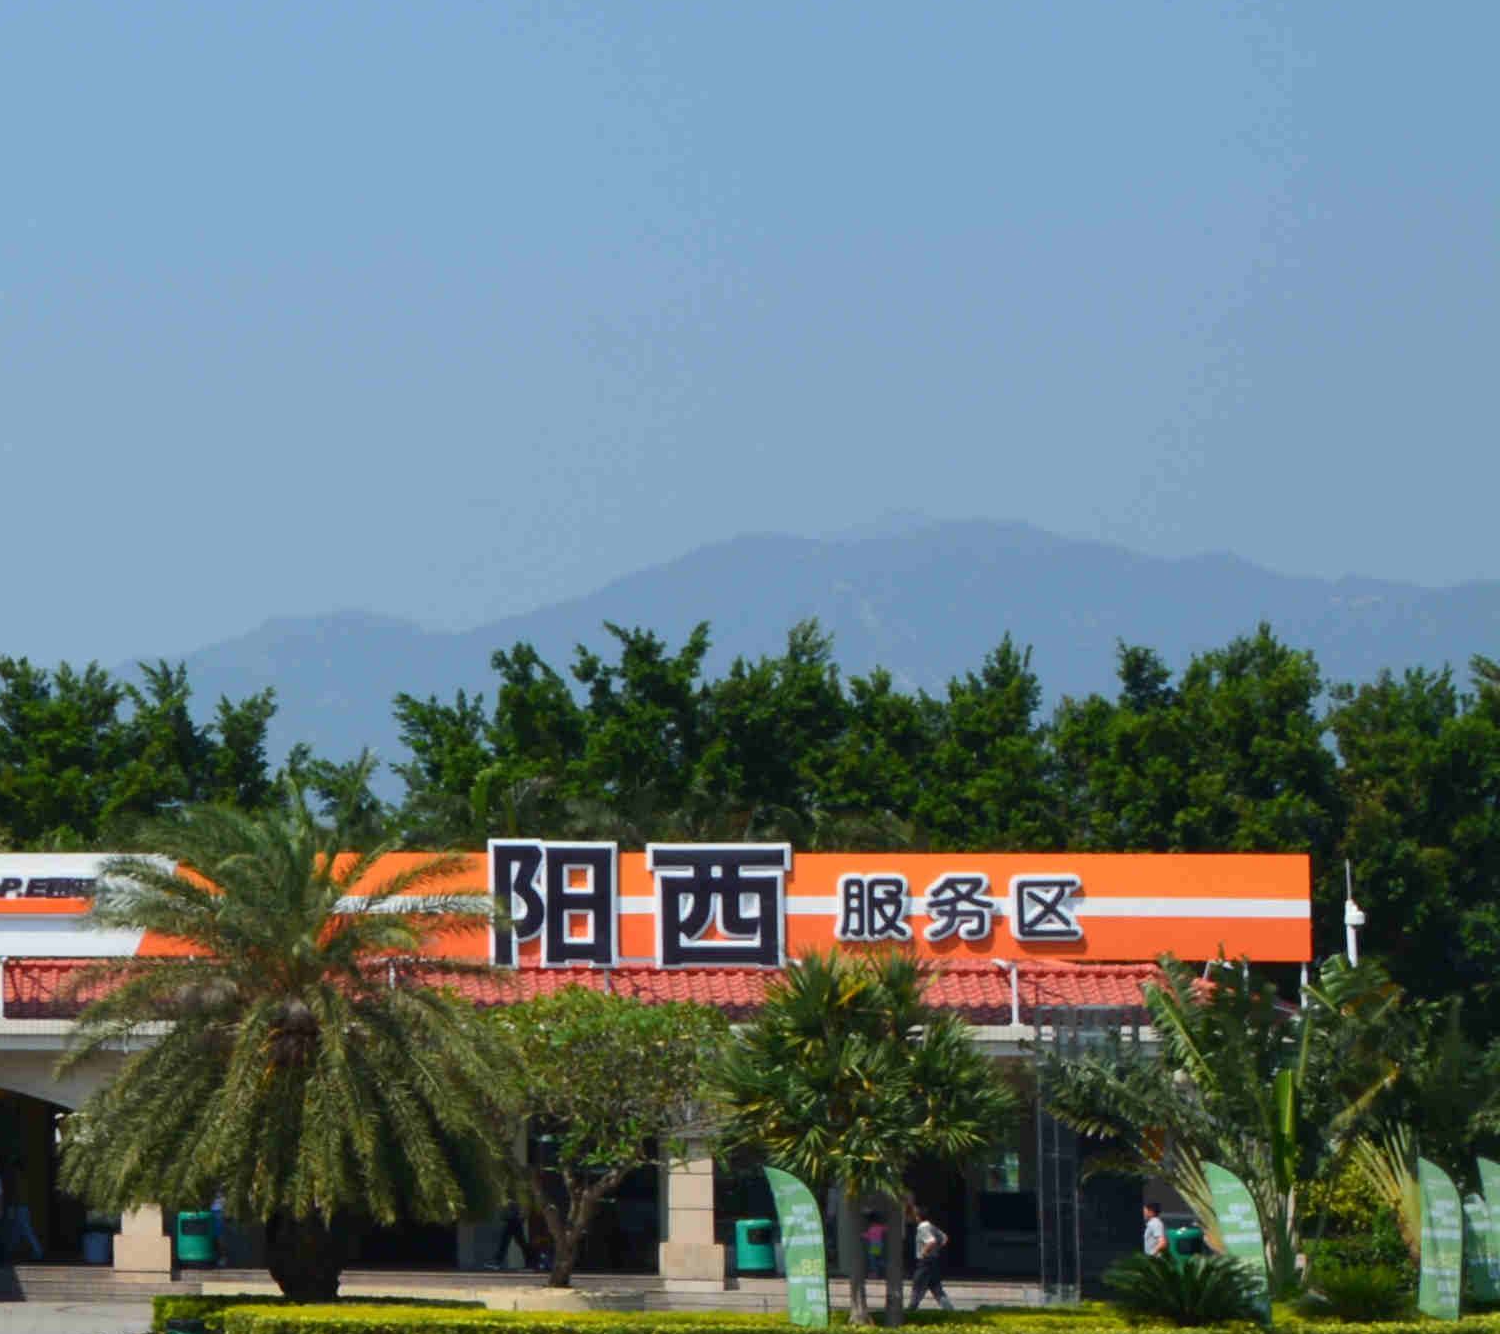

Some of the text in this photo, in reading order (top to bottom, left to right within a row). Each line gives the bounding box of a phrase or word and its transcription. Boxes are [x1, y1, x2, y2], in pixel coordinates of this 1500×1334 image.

[488, 839, 1082, 969] 阳西 服务区
